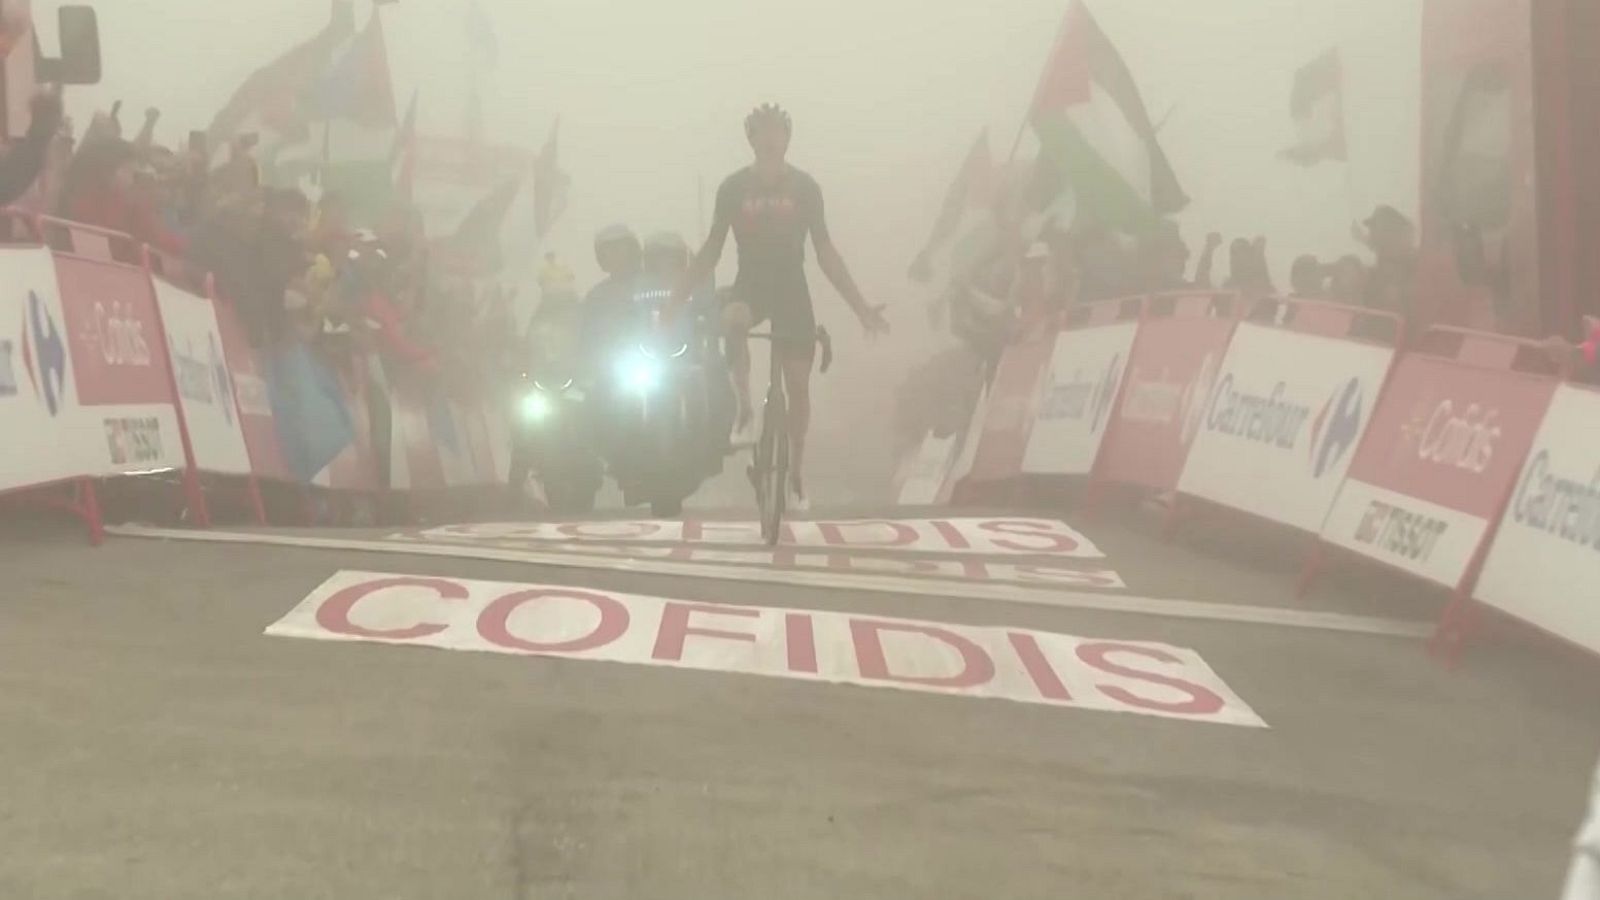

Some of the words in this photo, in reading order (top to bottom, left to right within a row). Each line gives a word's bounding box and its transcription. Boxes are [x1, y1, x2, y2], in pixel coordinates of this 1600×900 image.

[1207, 372, 1309, 450] Carrefour
[1419, 399, 1500, 472] Cofidis
[316, 576, 1226, 714] COFIDIS
